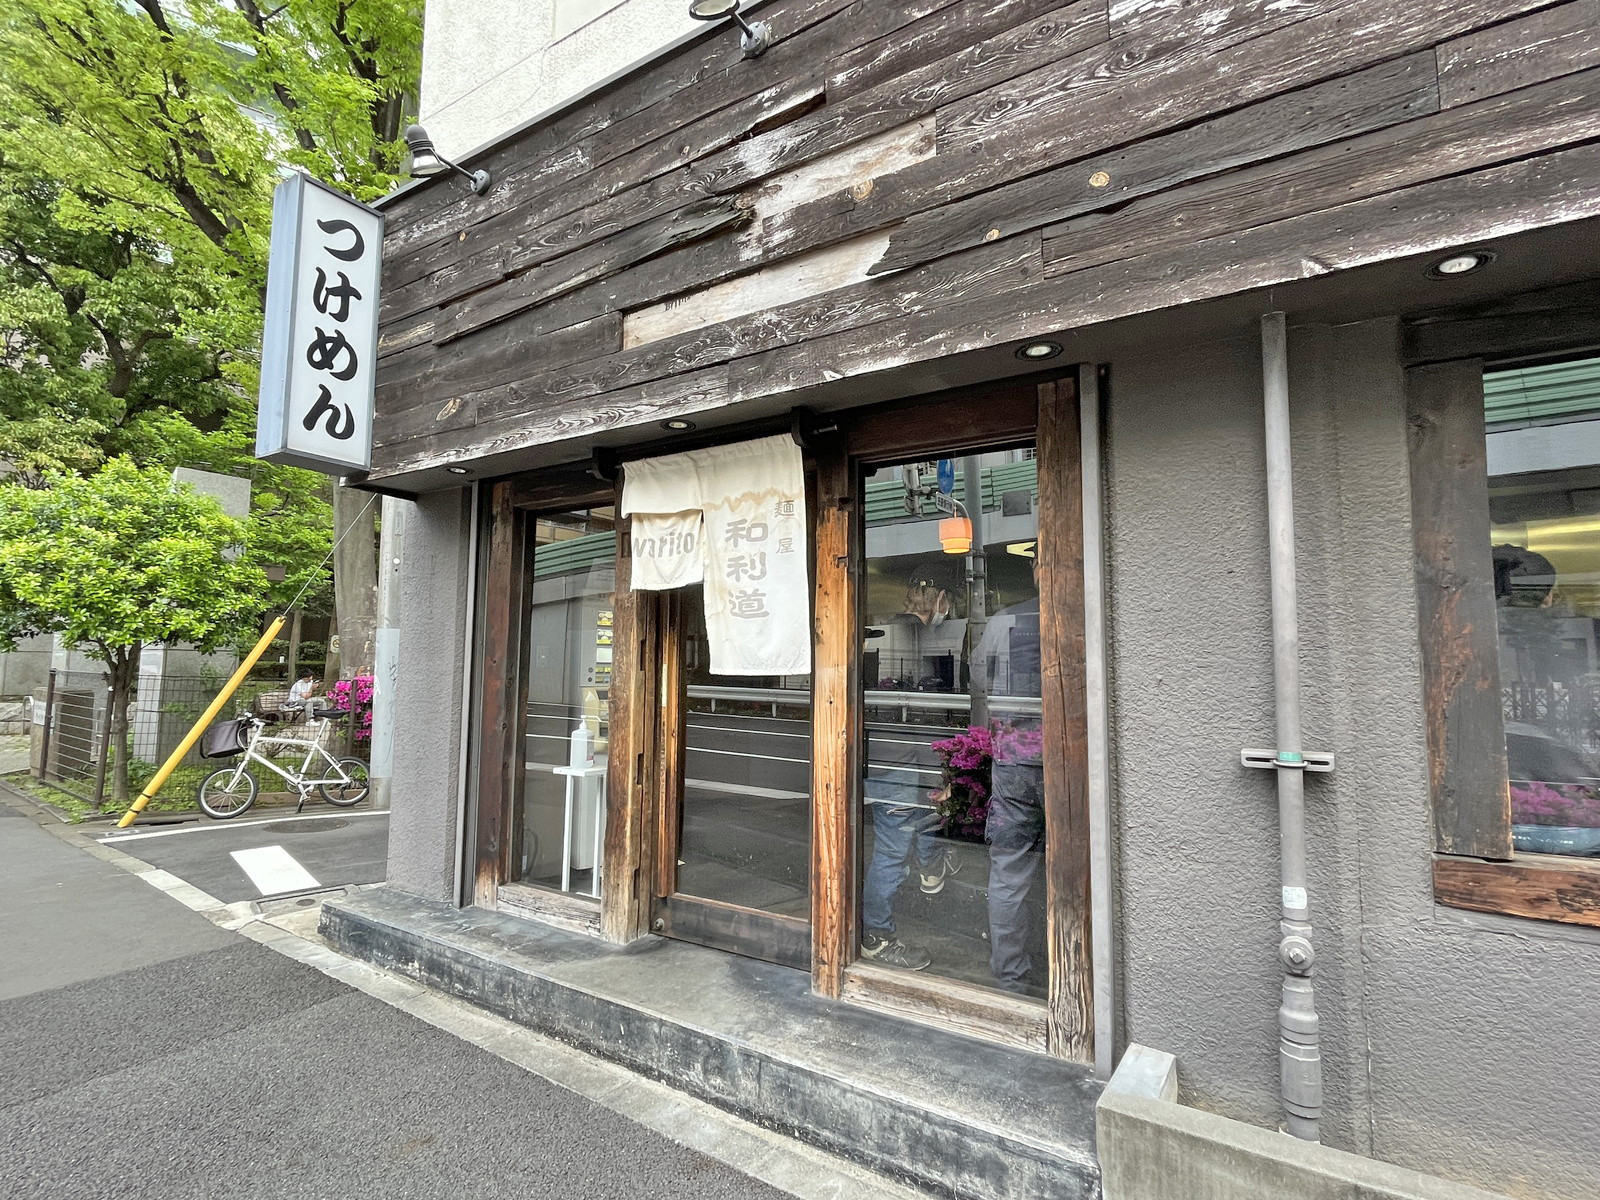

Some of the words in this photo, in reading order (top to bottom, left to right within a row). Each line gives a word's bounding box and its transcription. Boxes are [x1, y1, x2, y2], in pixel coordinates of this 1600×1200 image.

[302, 218, 365, 440] つけめん
[725, 518, 770, 619] 和利道
